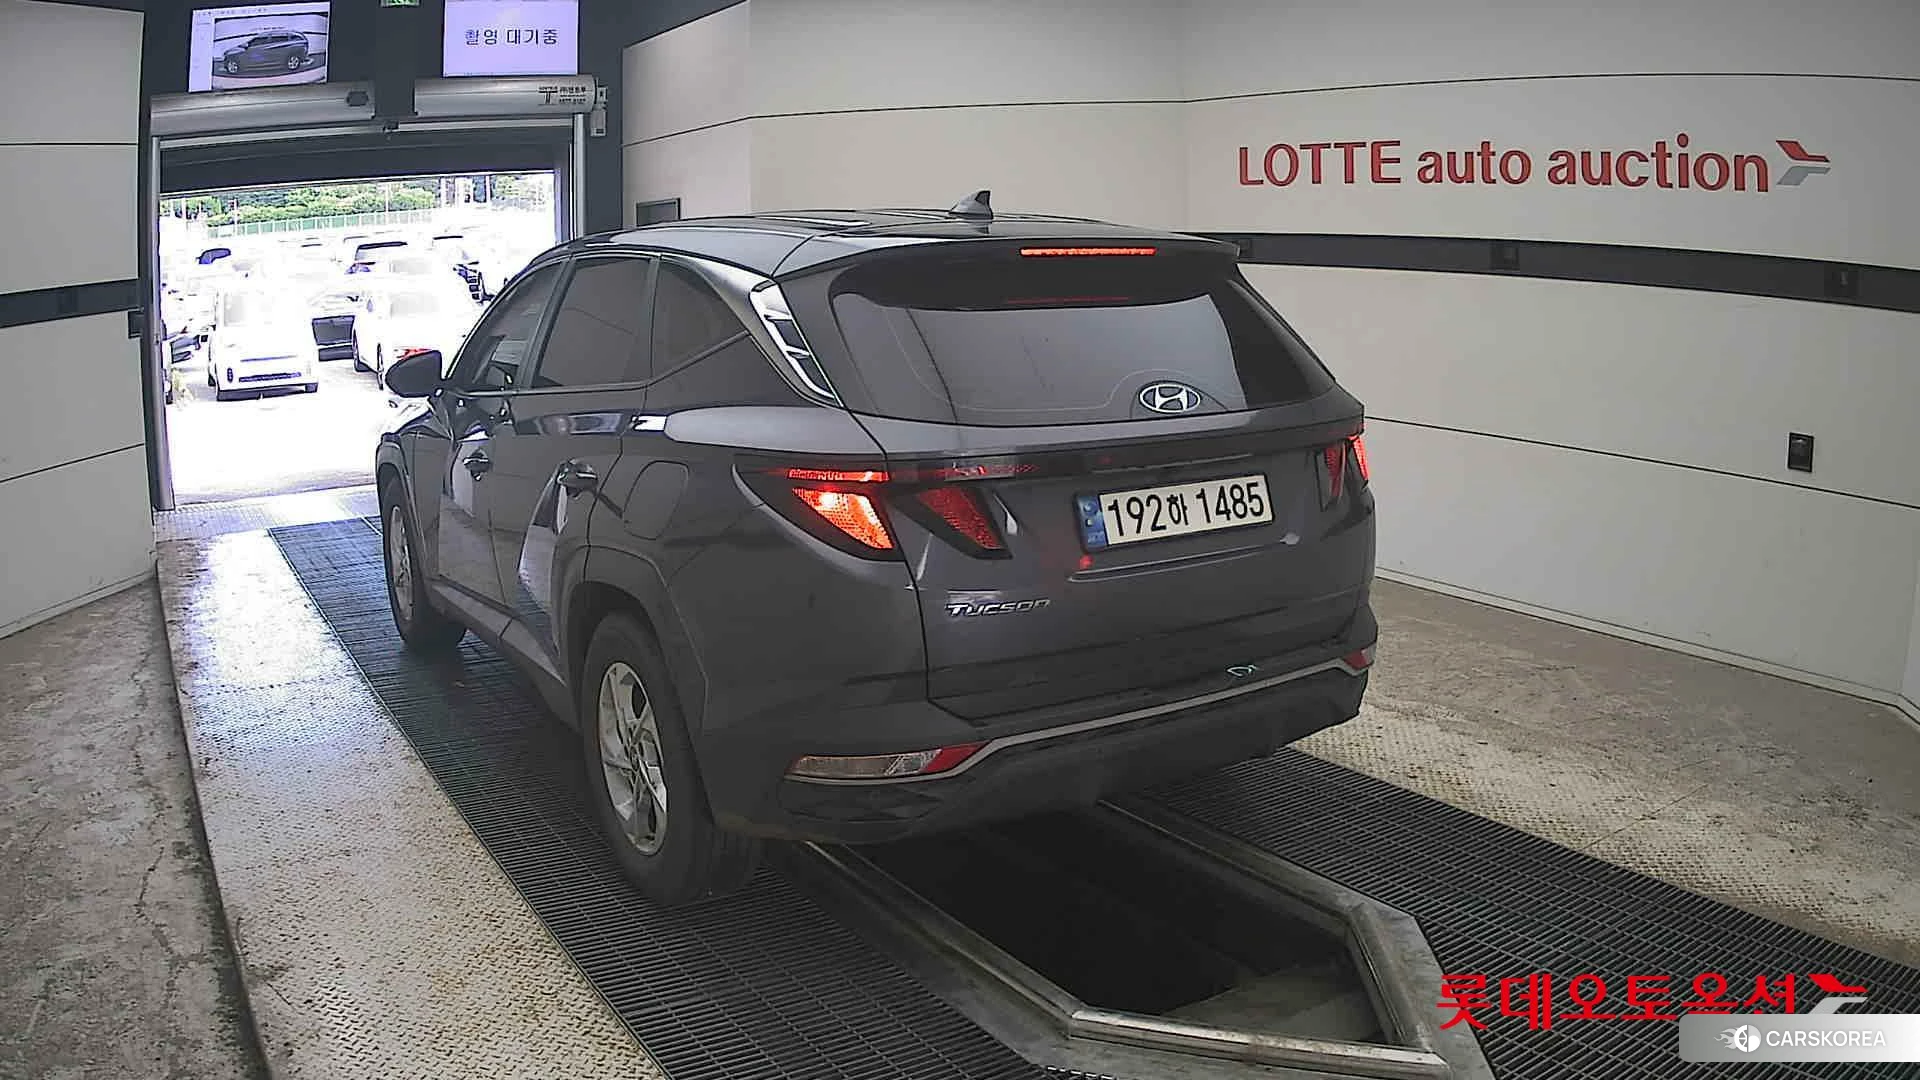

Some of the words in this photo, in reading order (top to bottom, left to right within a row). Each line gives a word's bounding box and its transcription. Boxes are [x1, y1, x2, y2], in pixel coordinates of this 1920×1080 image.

[506, 29, 558, 45] 대기중
[1238, 140, 1401, 187] LOTTE
[1416, 140, 1532, 185] auto
[1547, 133, 1769, 193] auction
[1108, 494, 1188, 536] 192하
[1196, 482, 1265, 524] 1485
